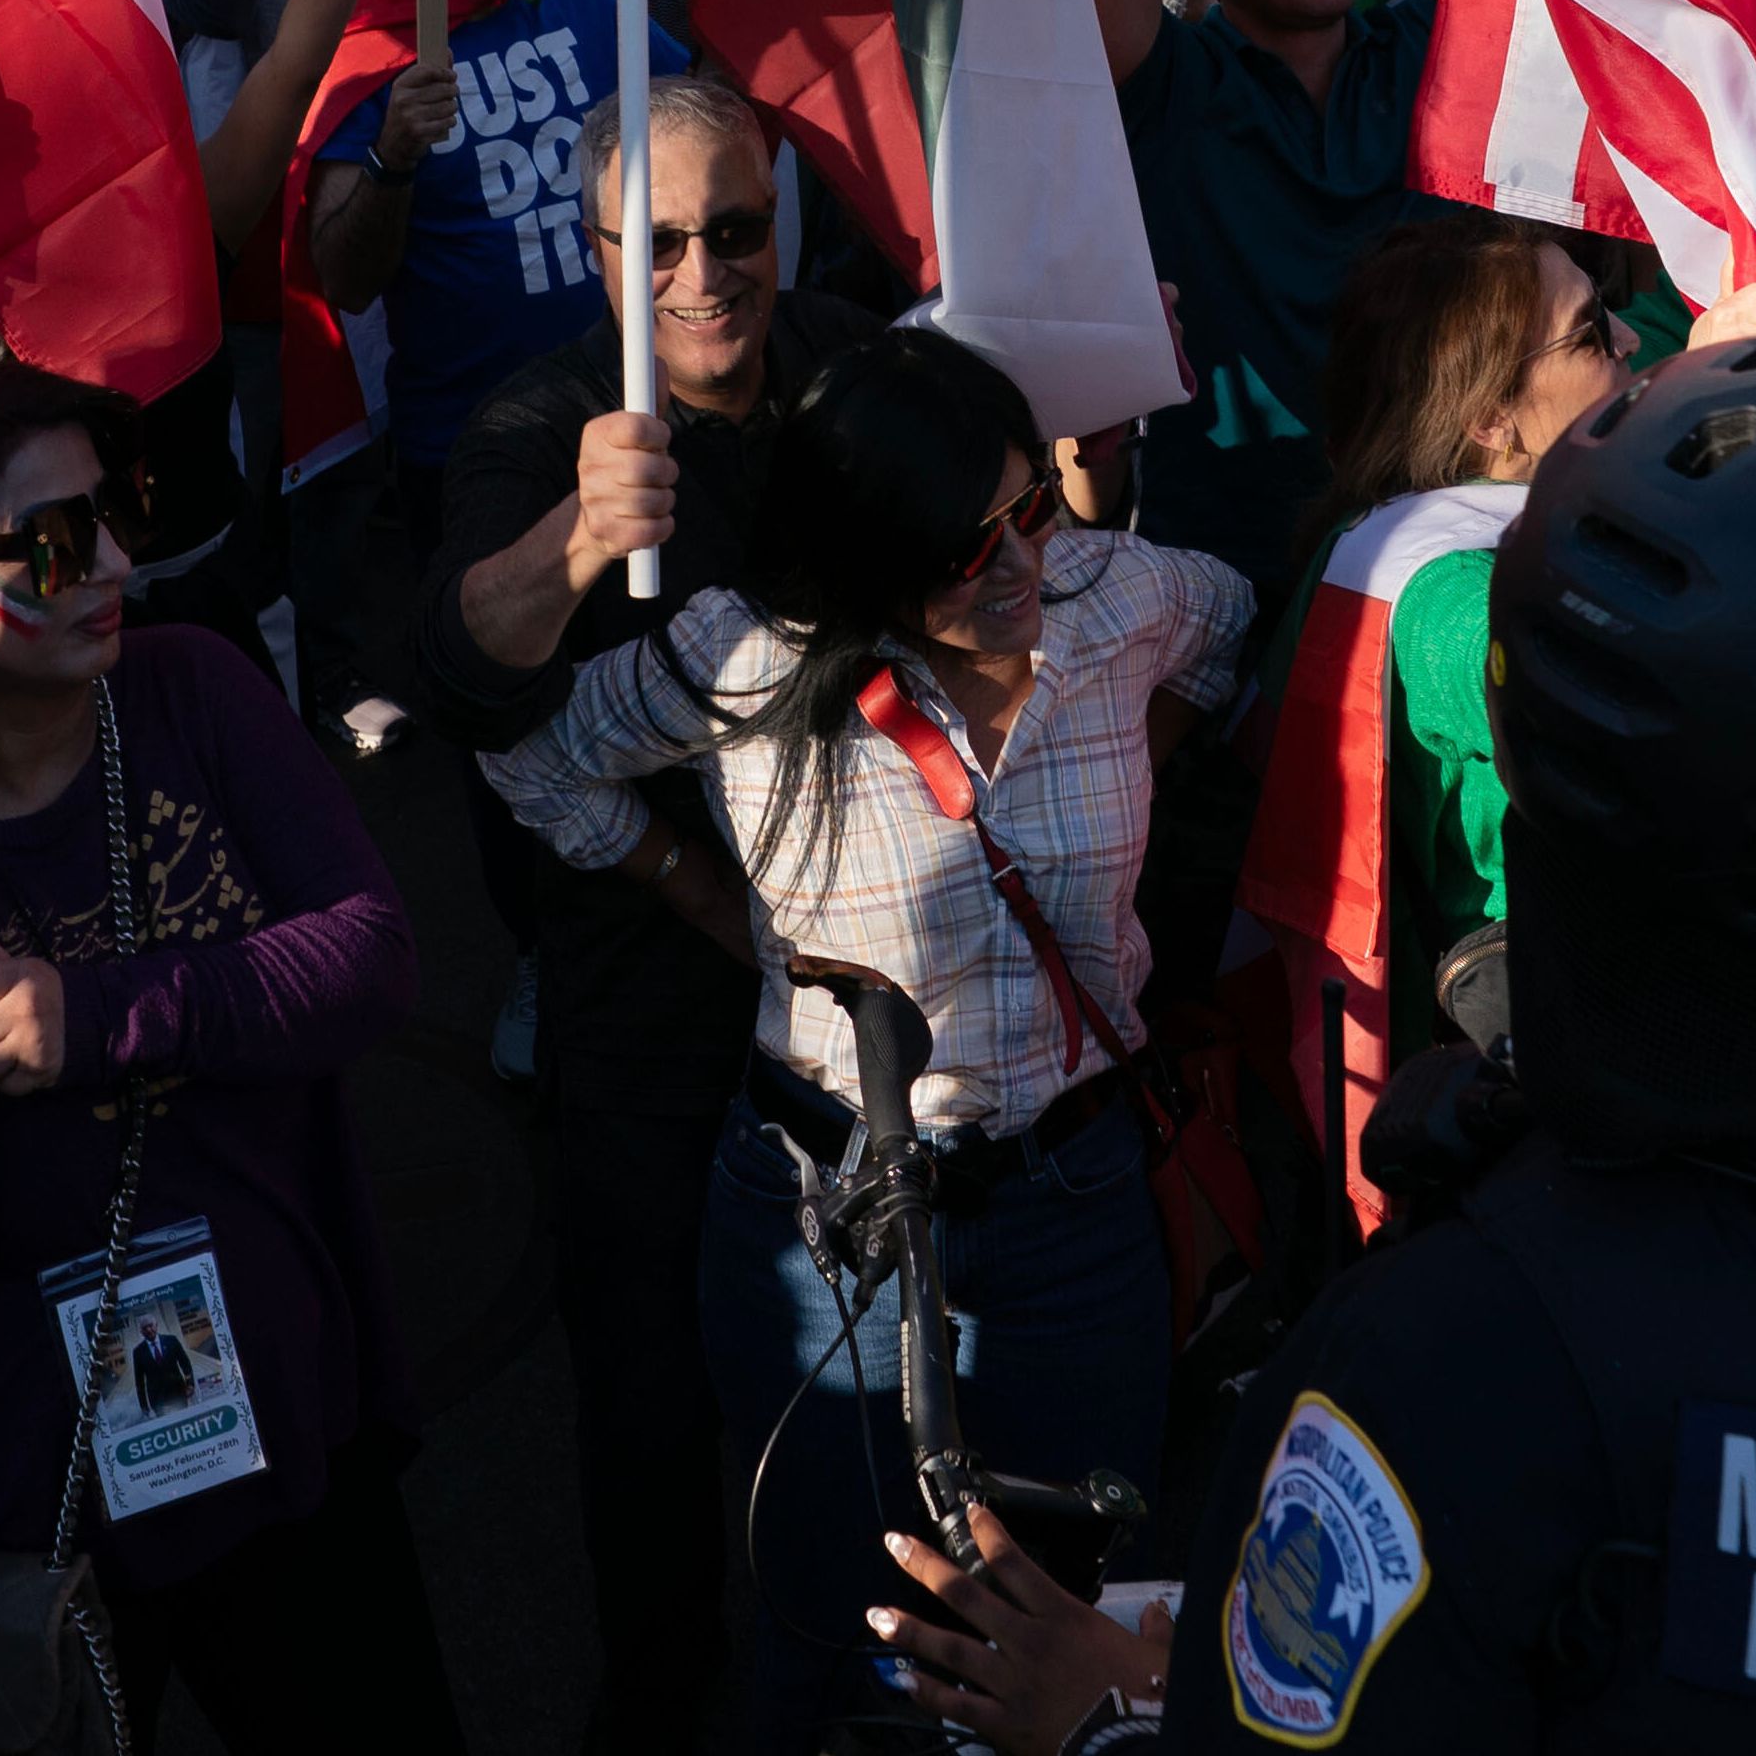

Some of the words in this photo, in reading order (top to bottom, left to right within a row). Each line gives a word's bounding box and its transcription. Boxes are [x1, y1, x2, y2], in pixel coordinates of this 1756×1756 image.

[430, 27, 590, 155] JUST
[475, 116, 584, 219] DO
[128, 1410, 226, 1461] SECURITY
[129, 1460, 174, 1483] Saturday,
[174, 1443, 217, 1468] February
[217, 1436, 240, 1453] 28th
[148, 1463, 207, 1490] Washington,
[207, 1456, 227, 1472] D.C.
[1358, 1491, 1413, 1586] POLICE
